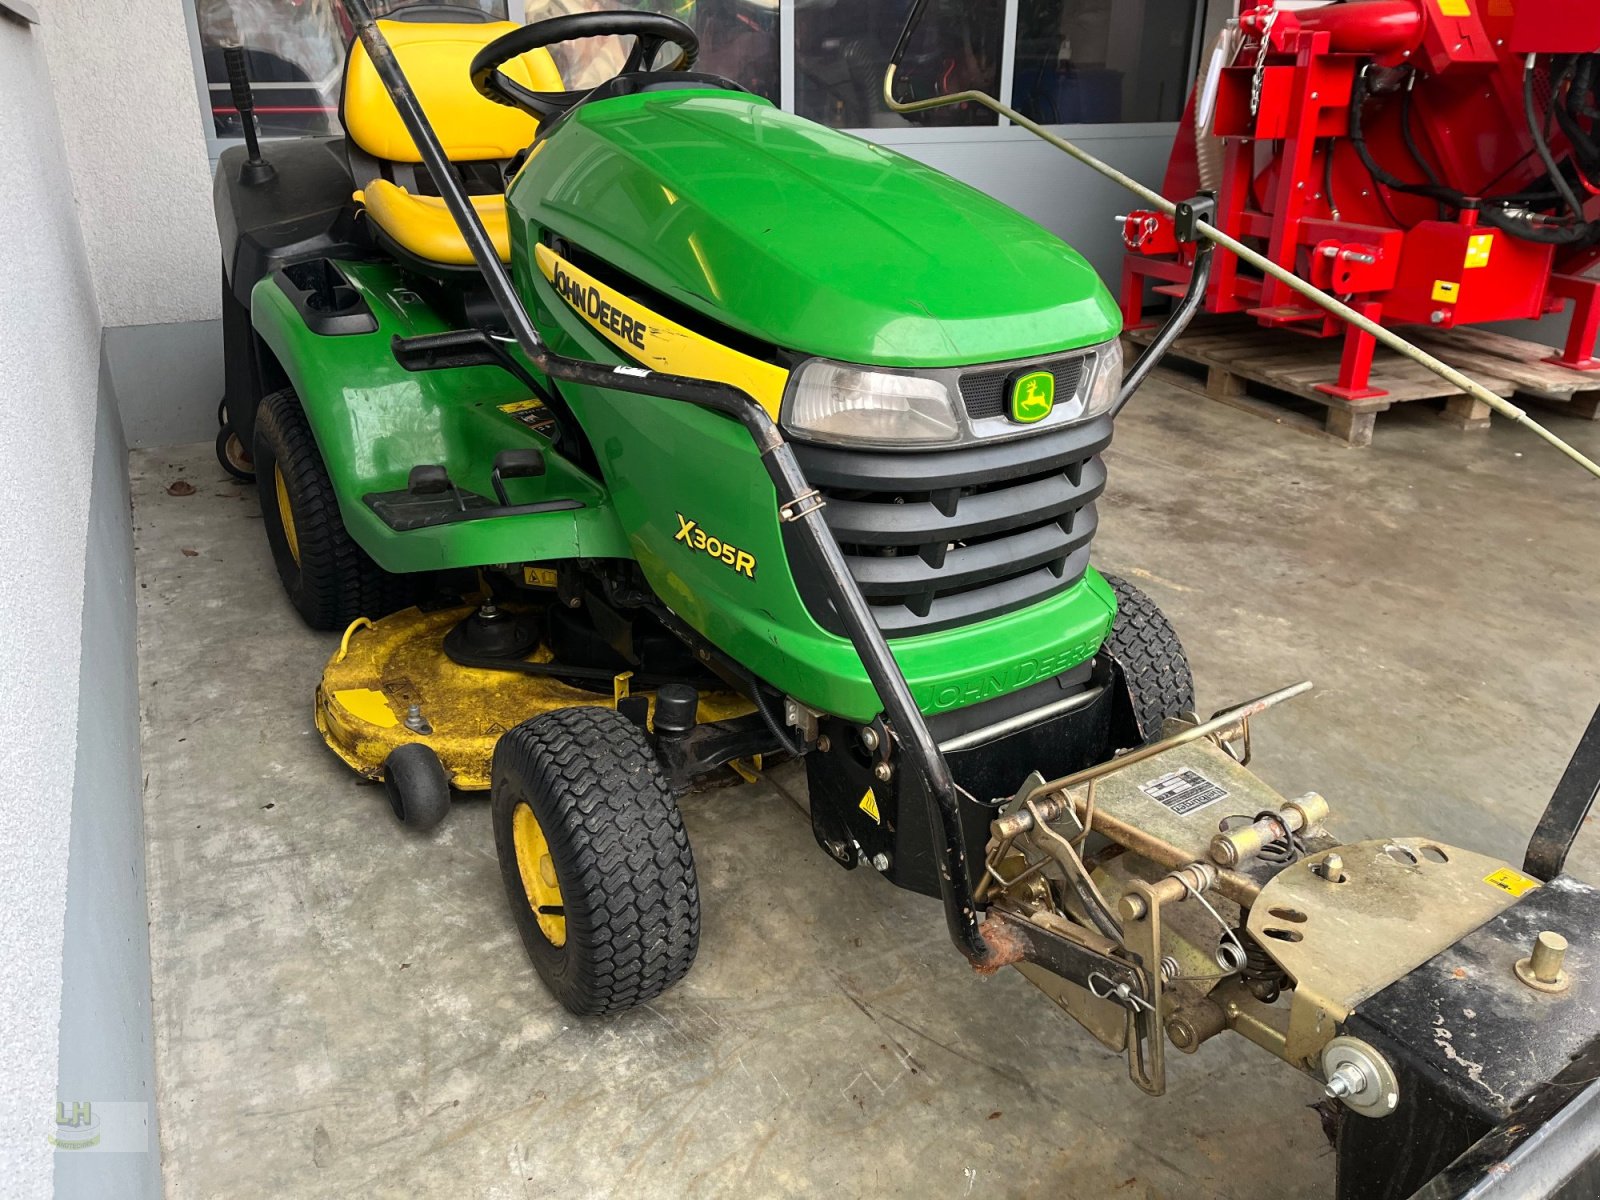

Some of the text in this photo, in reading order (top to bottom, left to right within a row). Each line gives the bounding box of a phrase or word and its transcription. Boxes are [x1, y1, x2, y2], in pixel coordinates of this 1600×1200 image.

[551, 261, 647, 351] JOHN DEERE
[674, 511, 756, 581] X305R
[920, 636, 1101, 713] JOHN DEERE
